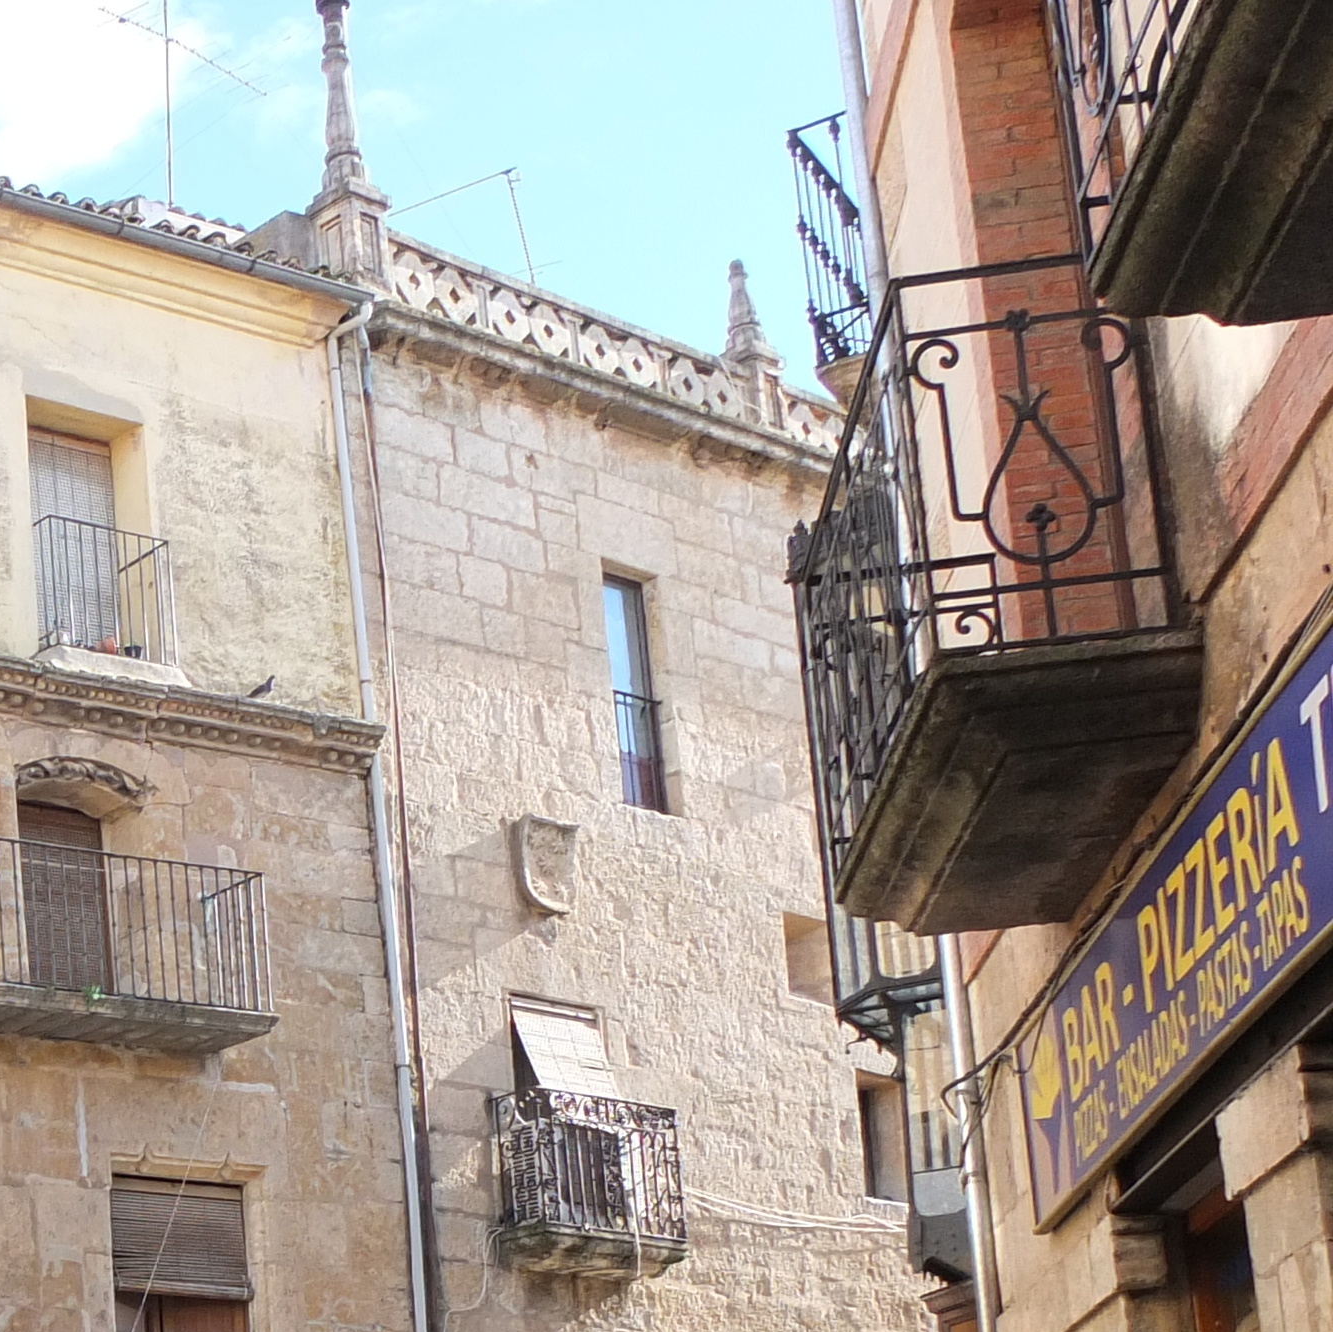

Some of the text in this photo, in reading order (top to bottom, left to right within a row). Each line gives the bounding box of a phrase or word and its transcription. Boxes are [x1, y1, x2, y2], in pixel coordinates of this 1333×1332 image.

[1062, 961, 1120, 1102] BAR
[1299, 663, 1333, 814] T
[1073, 1079, 1109, 1168] PIZZAS
[1115, 990, 1190, 1120] ENSALADAS
[1196, 919, 1252, 1037] PASTAS
[1257, 855, 1310, 972] TAPAS
